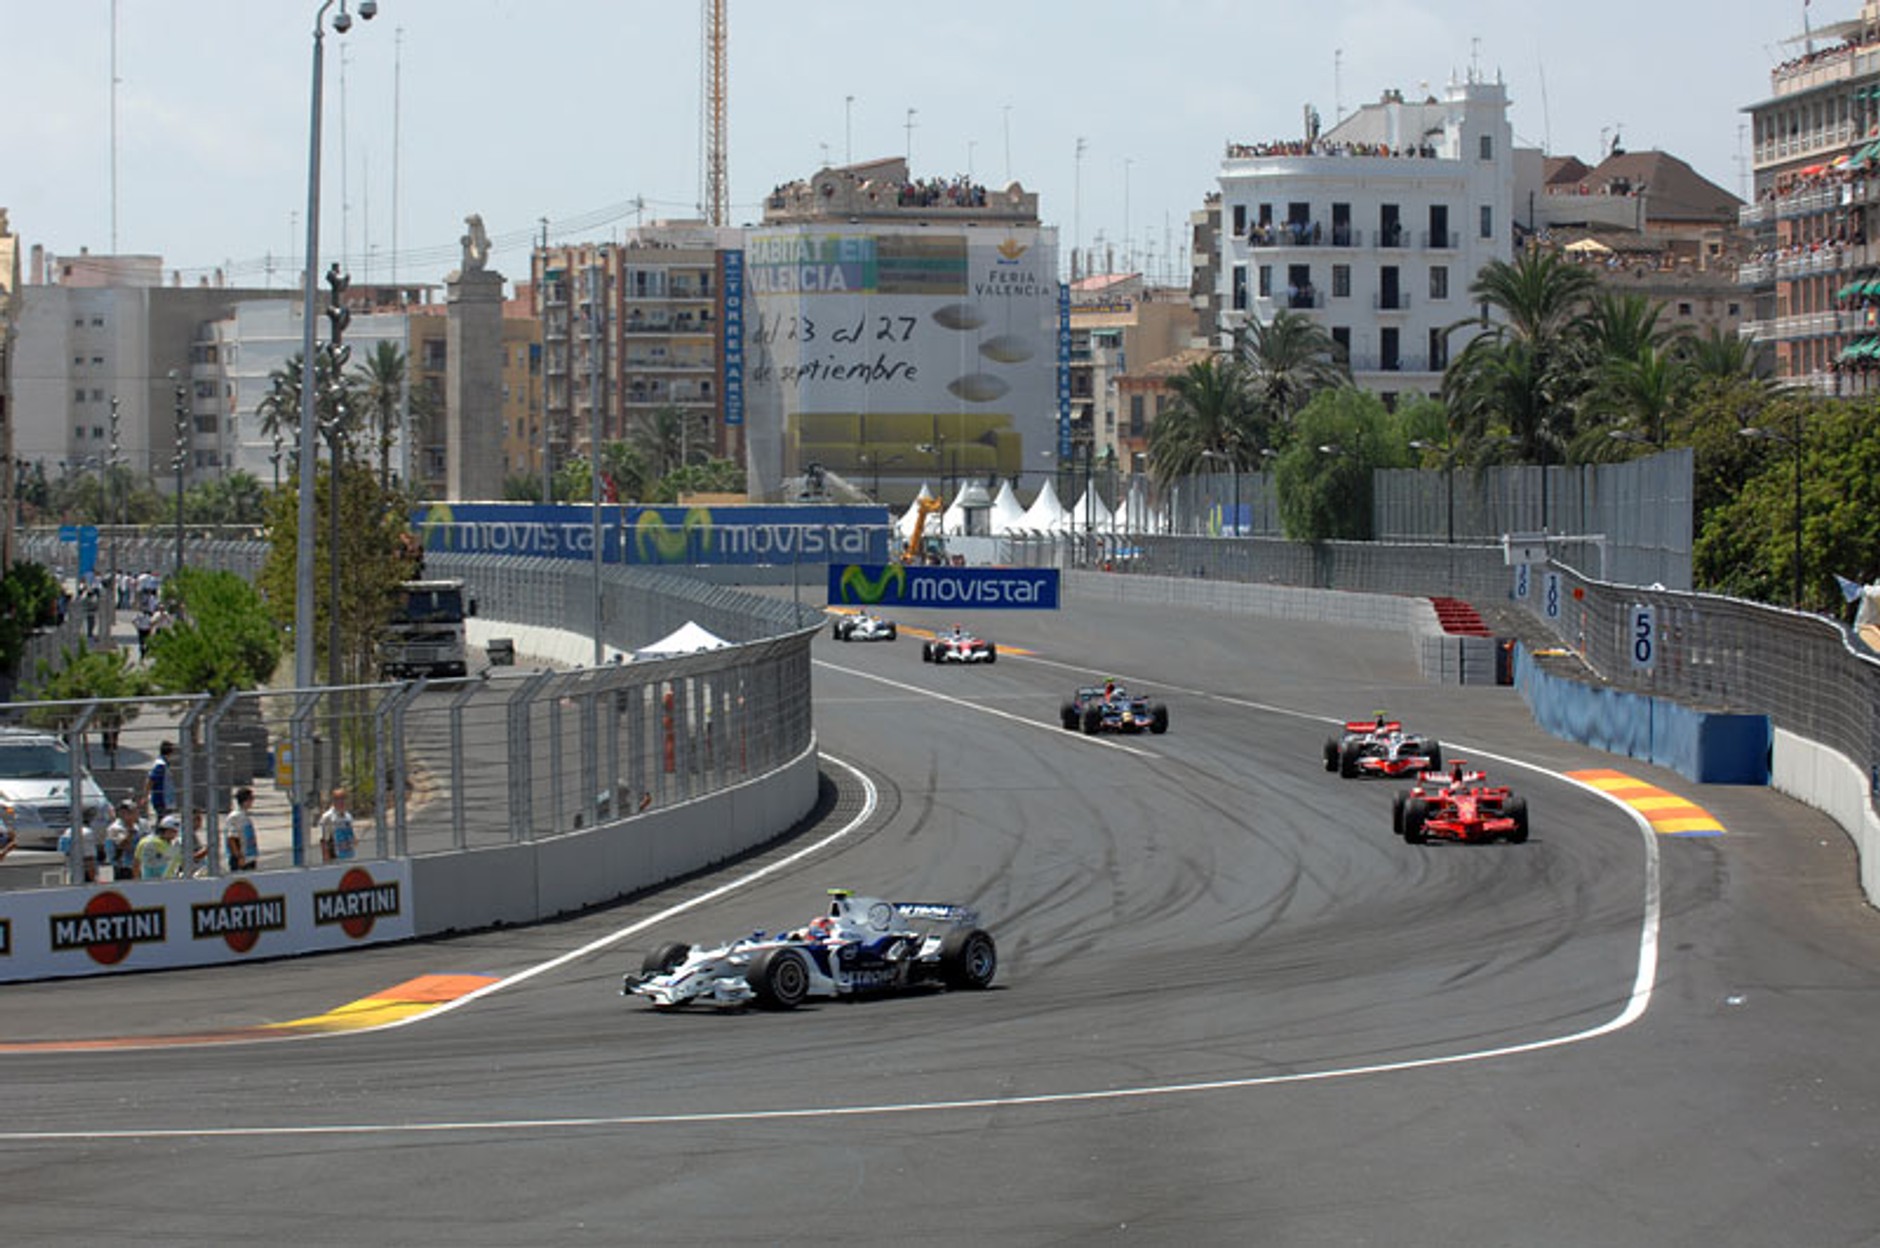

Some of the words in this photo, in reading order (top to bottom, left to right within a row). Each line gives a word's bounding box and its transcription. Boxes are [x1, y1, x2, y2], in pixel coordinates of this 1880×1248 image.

[748, 236, 827, 262] HABITAT
[750, 264, 847, 292] VALENCIA
[975, 283, 1050, 297] VALENCIA
[989, 270, 1035, 283] FERIA
[787, 316, 815, 342] 23
[832, 312, 866, 343] al
[876, 316, 917, 342] 27
[780, 354, 918, 386] septiembre
[460, 522, 614, 552] movistar
[720, 524, 876, 553] movistar
[912, 578, 1046, 602] movistar
[1635, 613, 1651, 662] 50
[197, 901, 282, 932] MARTINI
[317, 887, 397, 918] MARTINI
[55, 912, 161, 945] MARTINI
